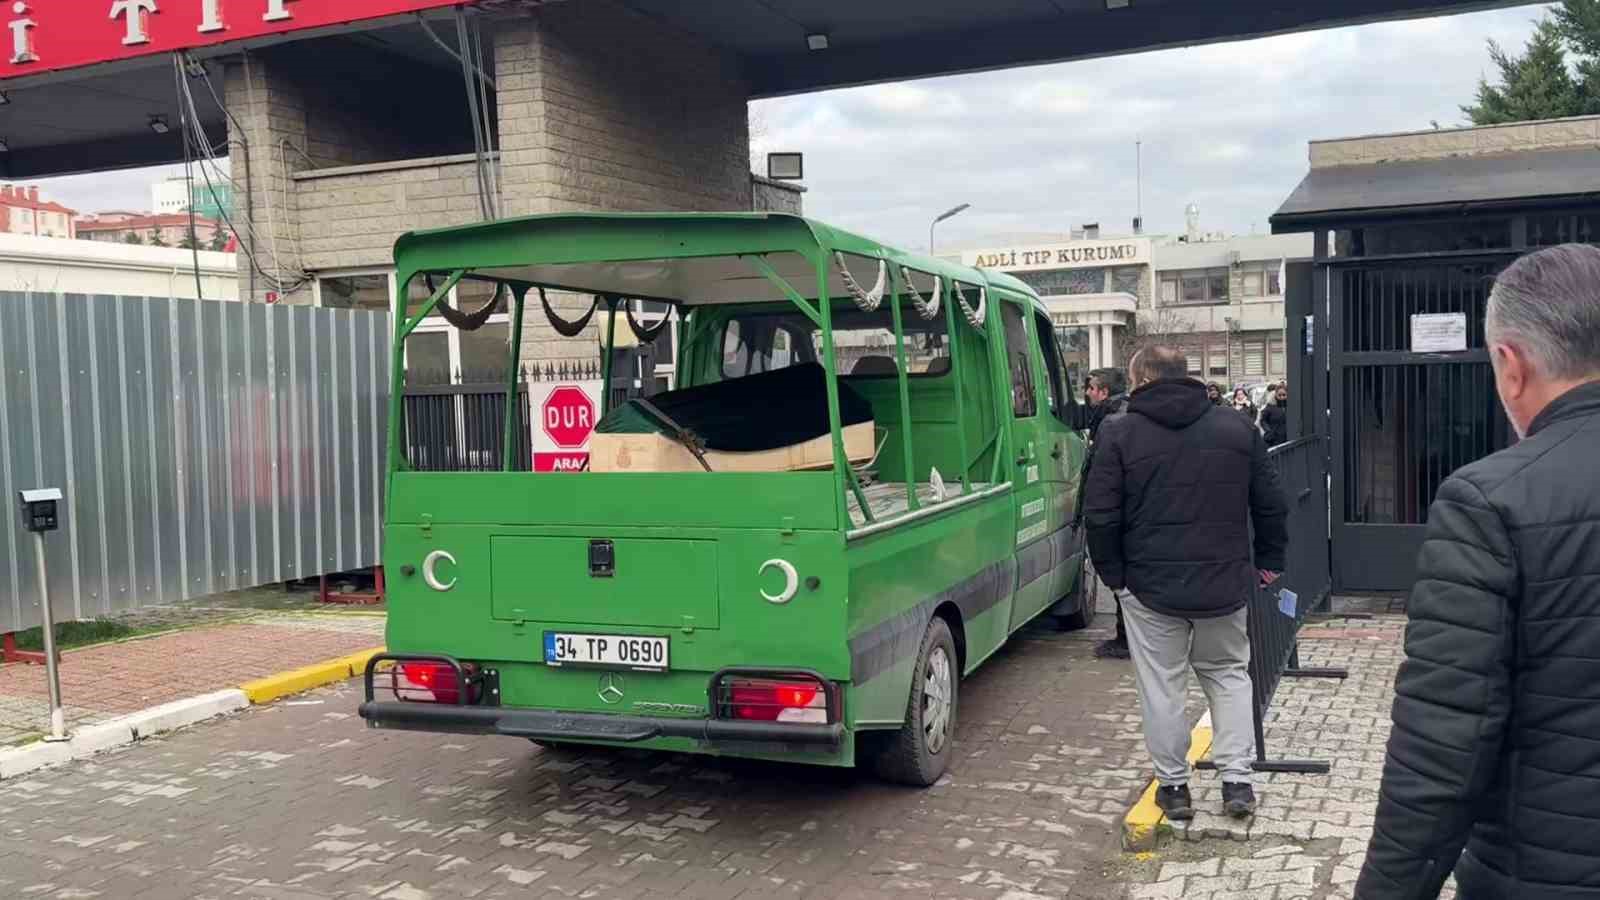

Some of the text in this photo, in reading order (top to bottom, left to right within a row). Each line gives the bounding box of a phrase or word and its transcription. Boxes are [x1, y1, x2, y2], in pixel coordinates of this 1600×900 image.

[975, 244, 1137, 267] ADLİ TIP KURUMU
[547, 405, 590, 428] DUR
[556, 637, 663, 663] 34 TP 0690
